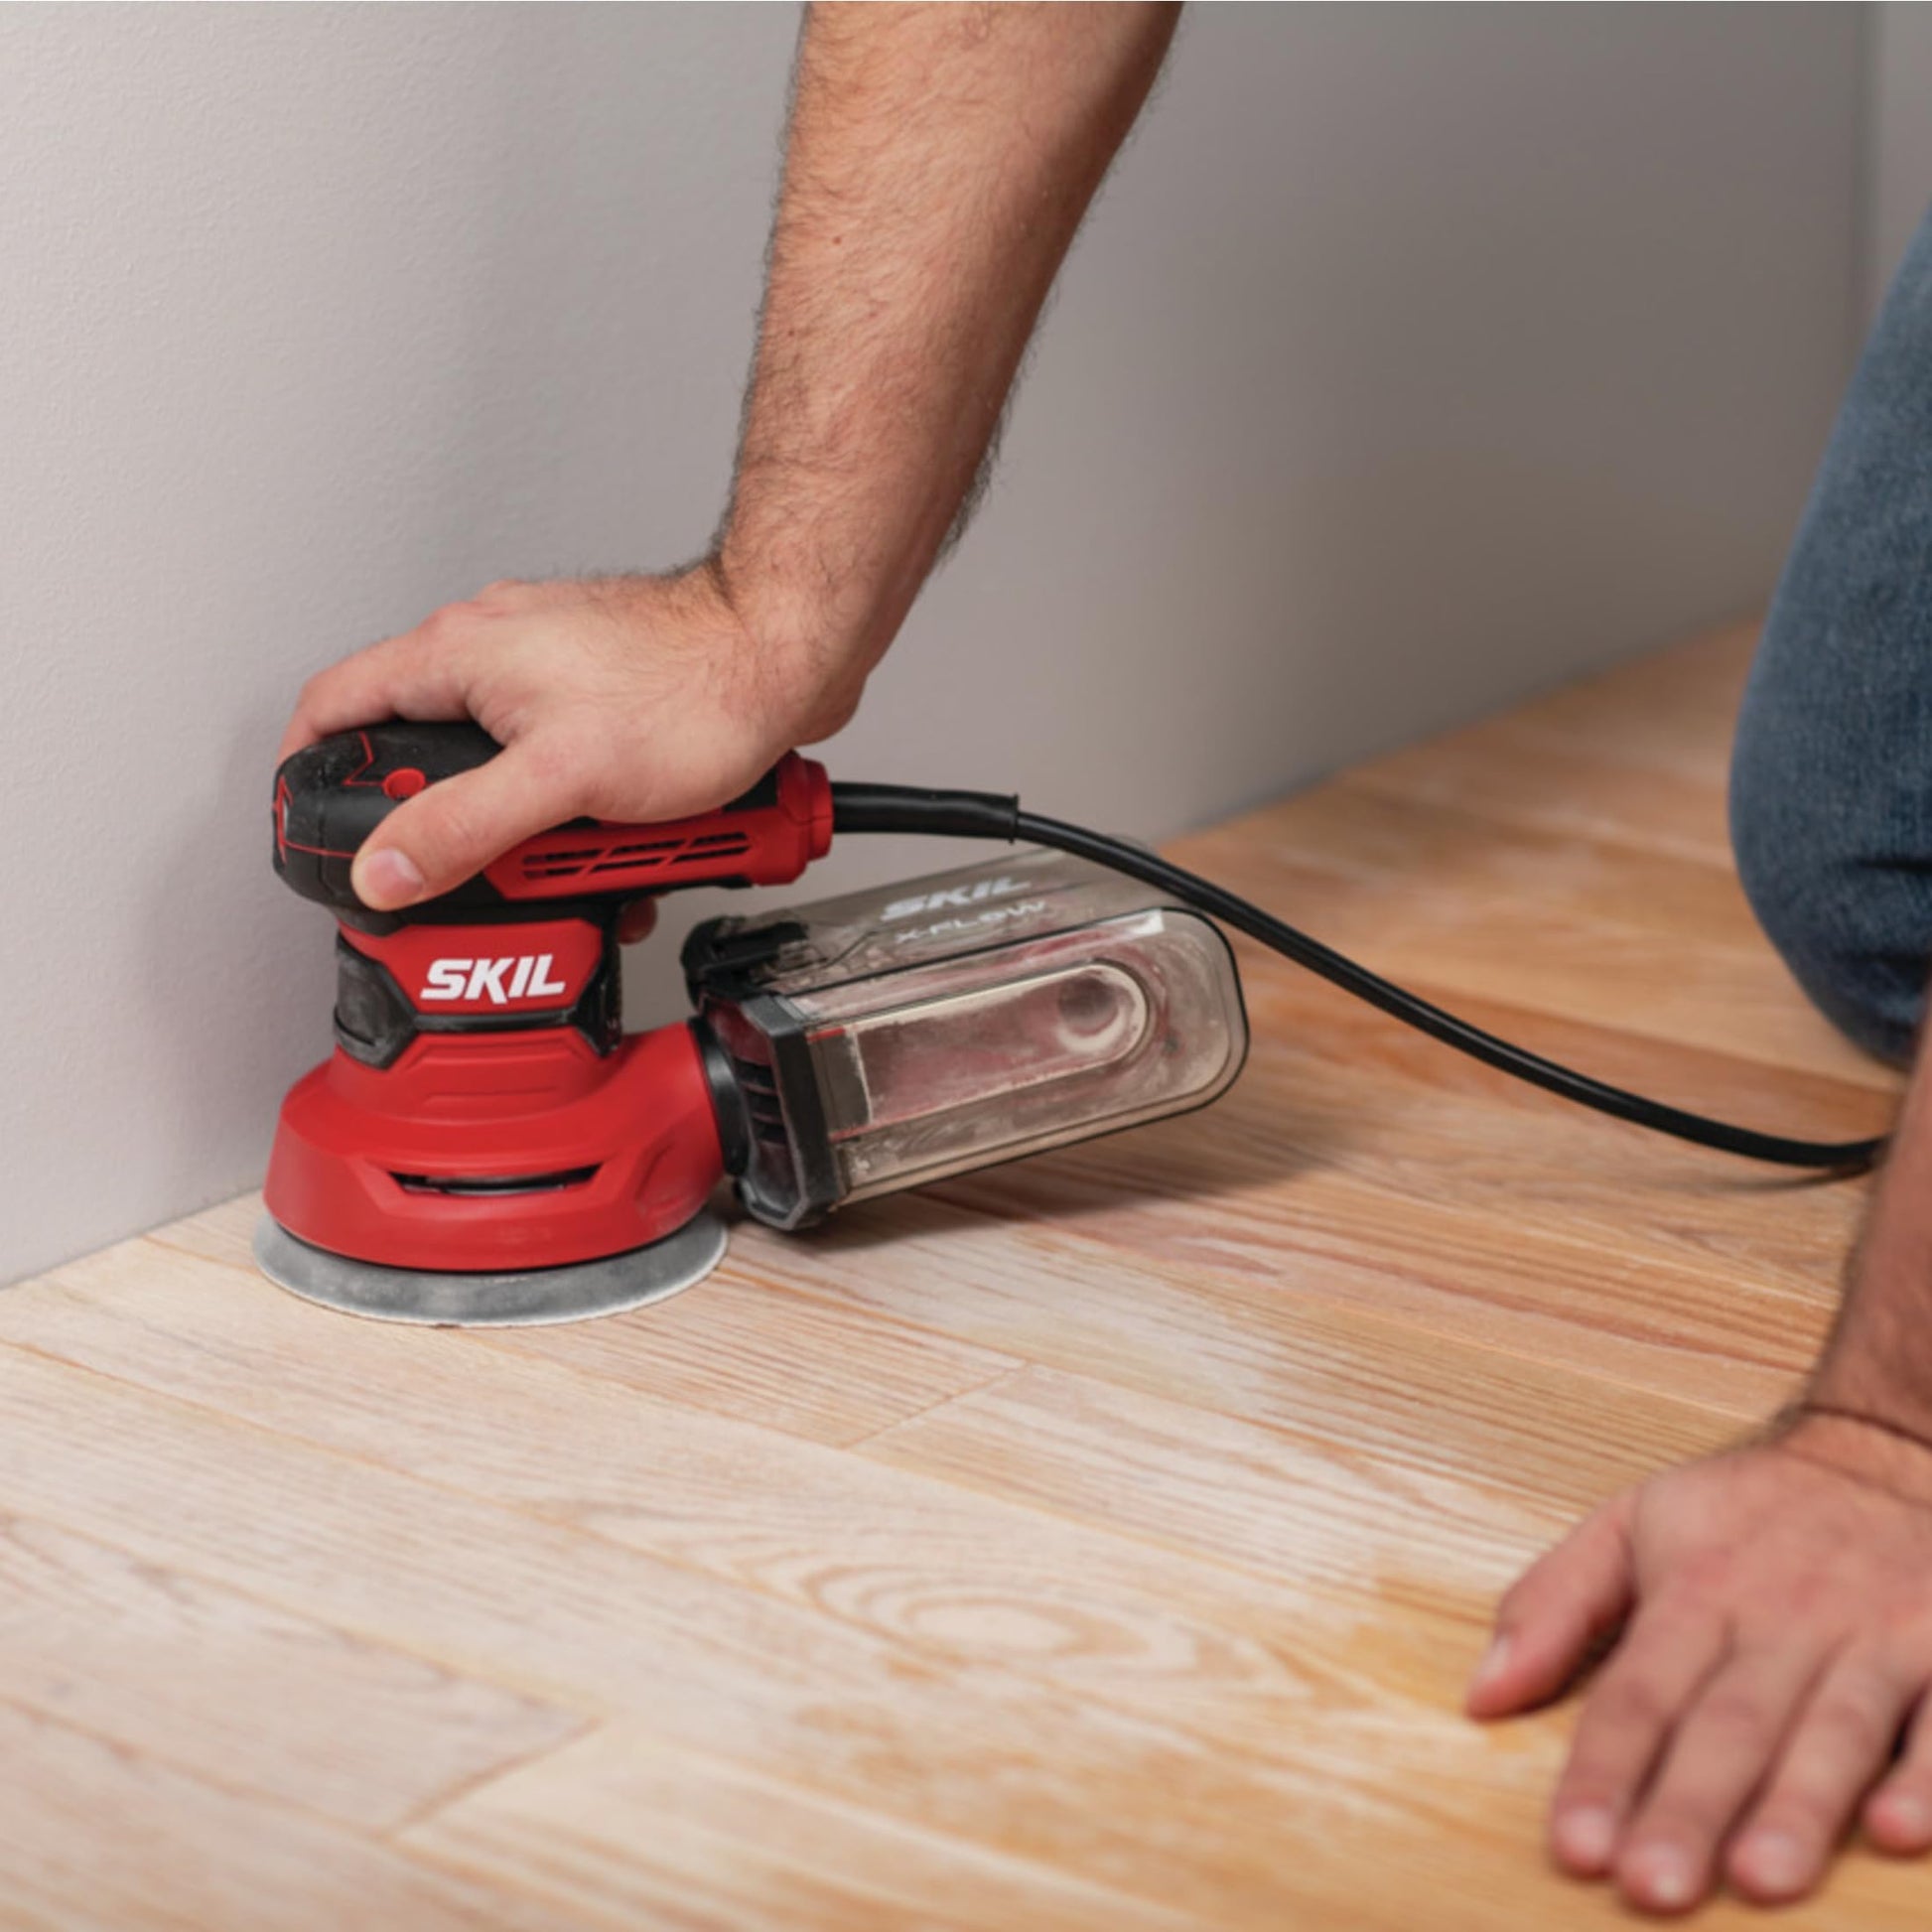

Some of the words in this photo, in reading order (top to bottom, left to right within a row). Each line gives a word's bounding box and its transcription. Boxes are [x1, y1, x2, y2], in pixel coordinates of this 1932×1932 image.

[881, 877, 1032, 921] SKIL
[896, 900, 1045, 942] X-FLOW
[420, 953, 566, 1005] SKIL
